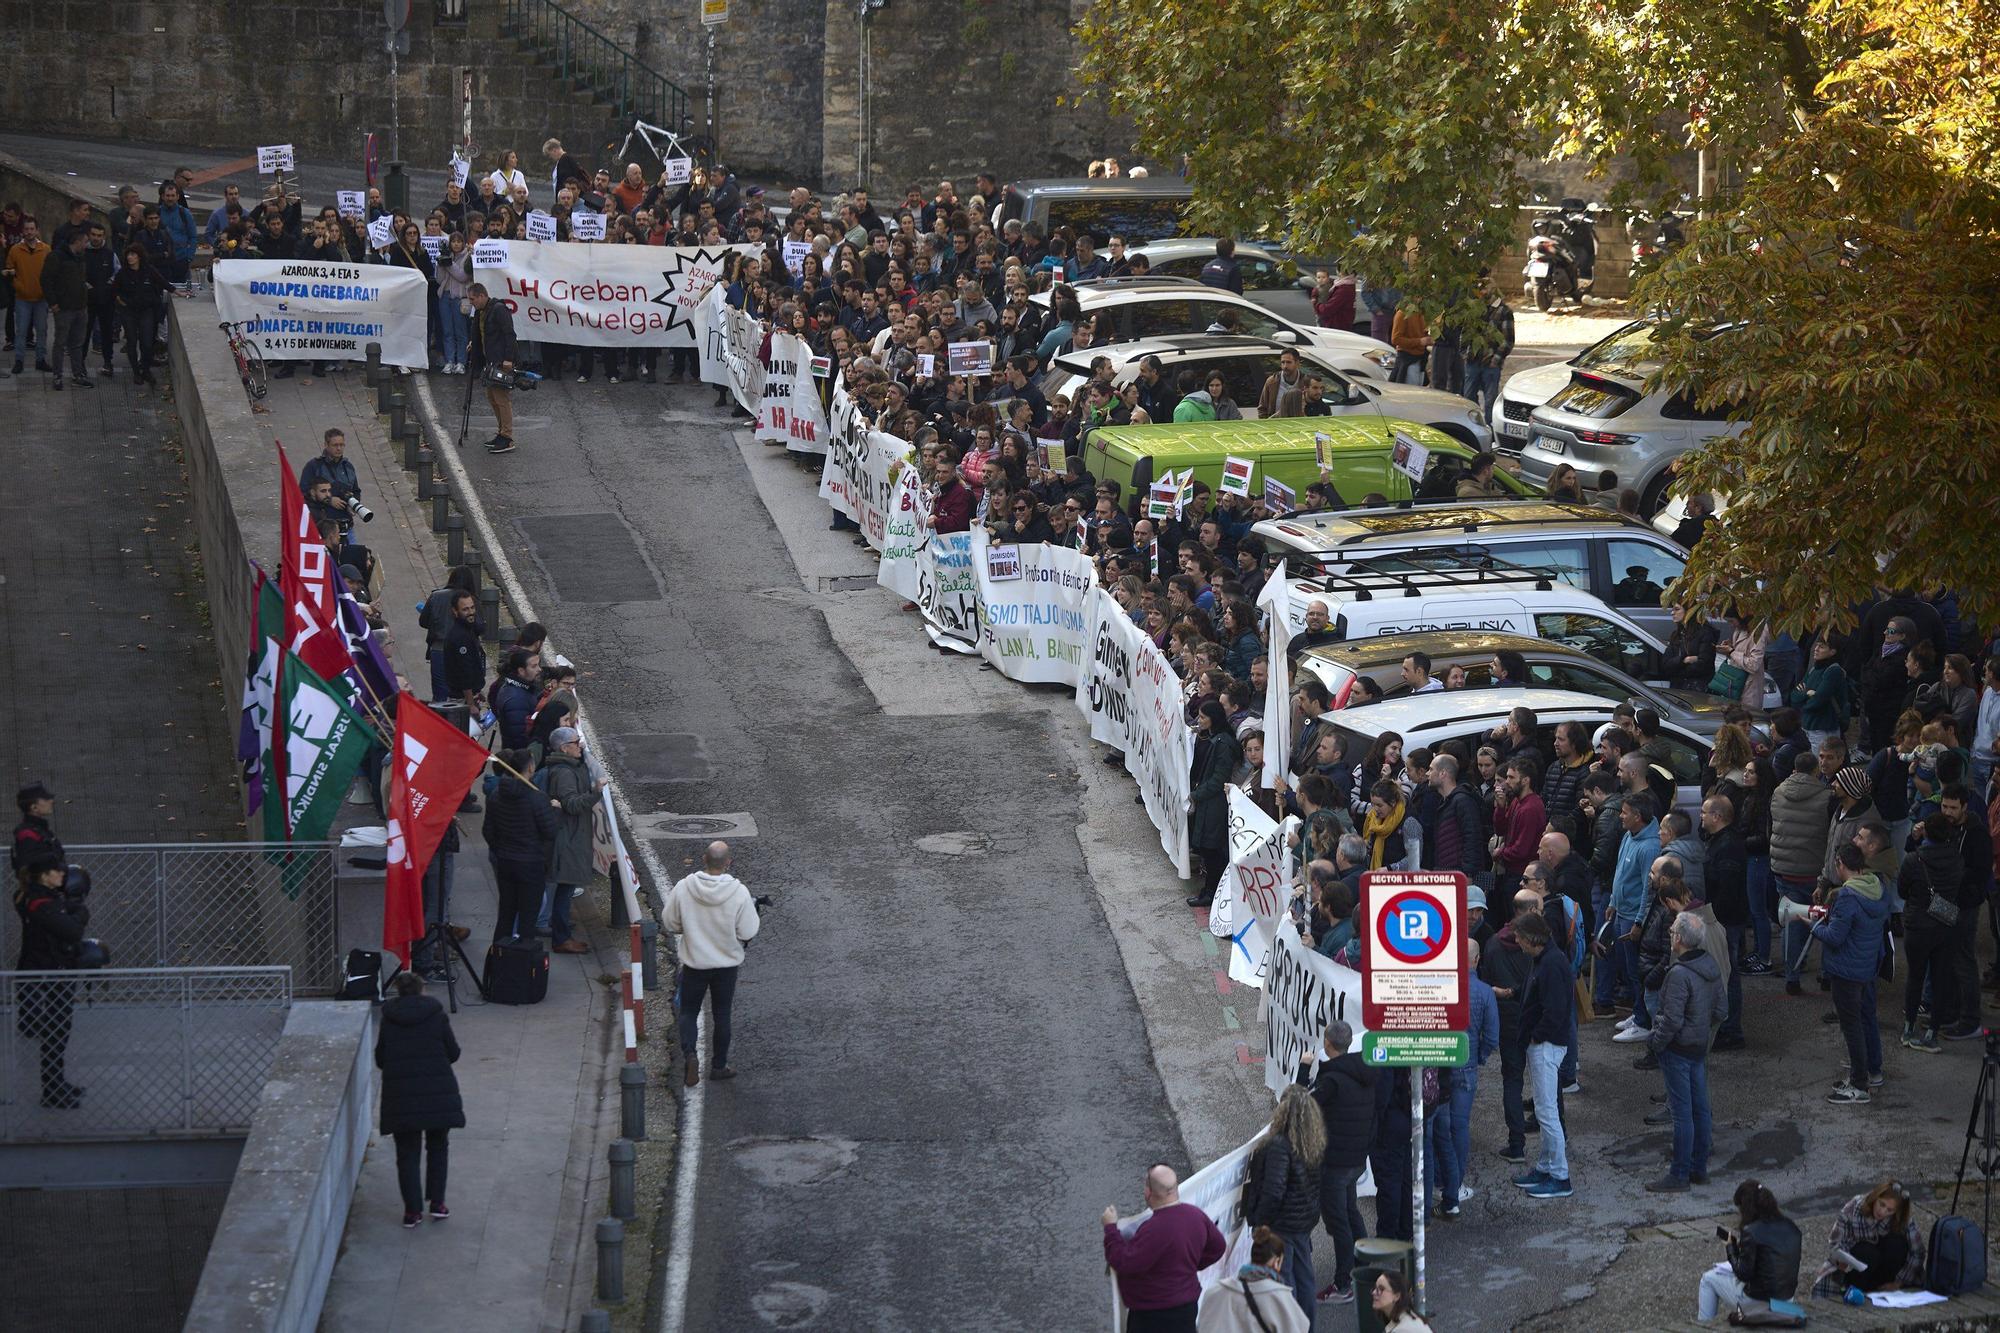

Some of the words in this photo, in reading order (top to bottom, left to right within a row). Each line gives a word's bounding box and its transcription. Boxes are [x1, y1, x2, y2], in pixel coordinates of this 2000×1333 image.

[532, 220, 547, 229] DUAL
[281, 266, 320, 278] AZAROAK
[320, 267, 328, 279] 3,
[329, 268, 336, 276] 4
[338, 268, 352, 280] ETA
[353, 269, 360, 280] 5
[250, 281, 308, 298] DONAPEA
[311, 284, 379, 302] GREBARA!!
[506, 276, 539, 300] LH
[549, 279, 648, 303] Greban
[528, 304, 561, 326] en
[566, 304, 664, 336] huelga
[246, 319, 304, 334] DONAPEA
[307, 320, 323, 334] EN
[326, 322, 384, 337] HUELGA!!
[264, 338, 274, 350] 3,
[274, 338, 282, 348] 4
[283, 338, 290, 348] Y
[290, 338, 297, 348] 5
[298, 338, 309, 350] DE
[309, 339, 358, 350] NOVIEMBRE
[990, 552, 1016, 561] ¡DIMISIÓN!
[1370, 875, 1402, 884] SECTOR
[1404, 875, 1412, 884] 1.
[1413, 875, 1456, 884] SEKTOREA
